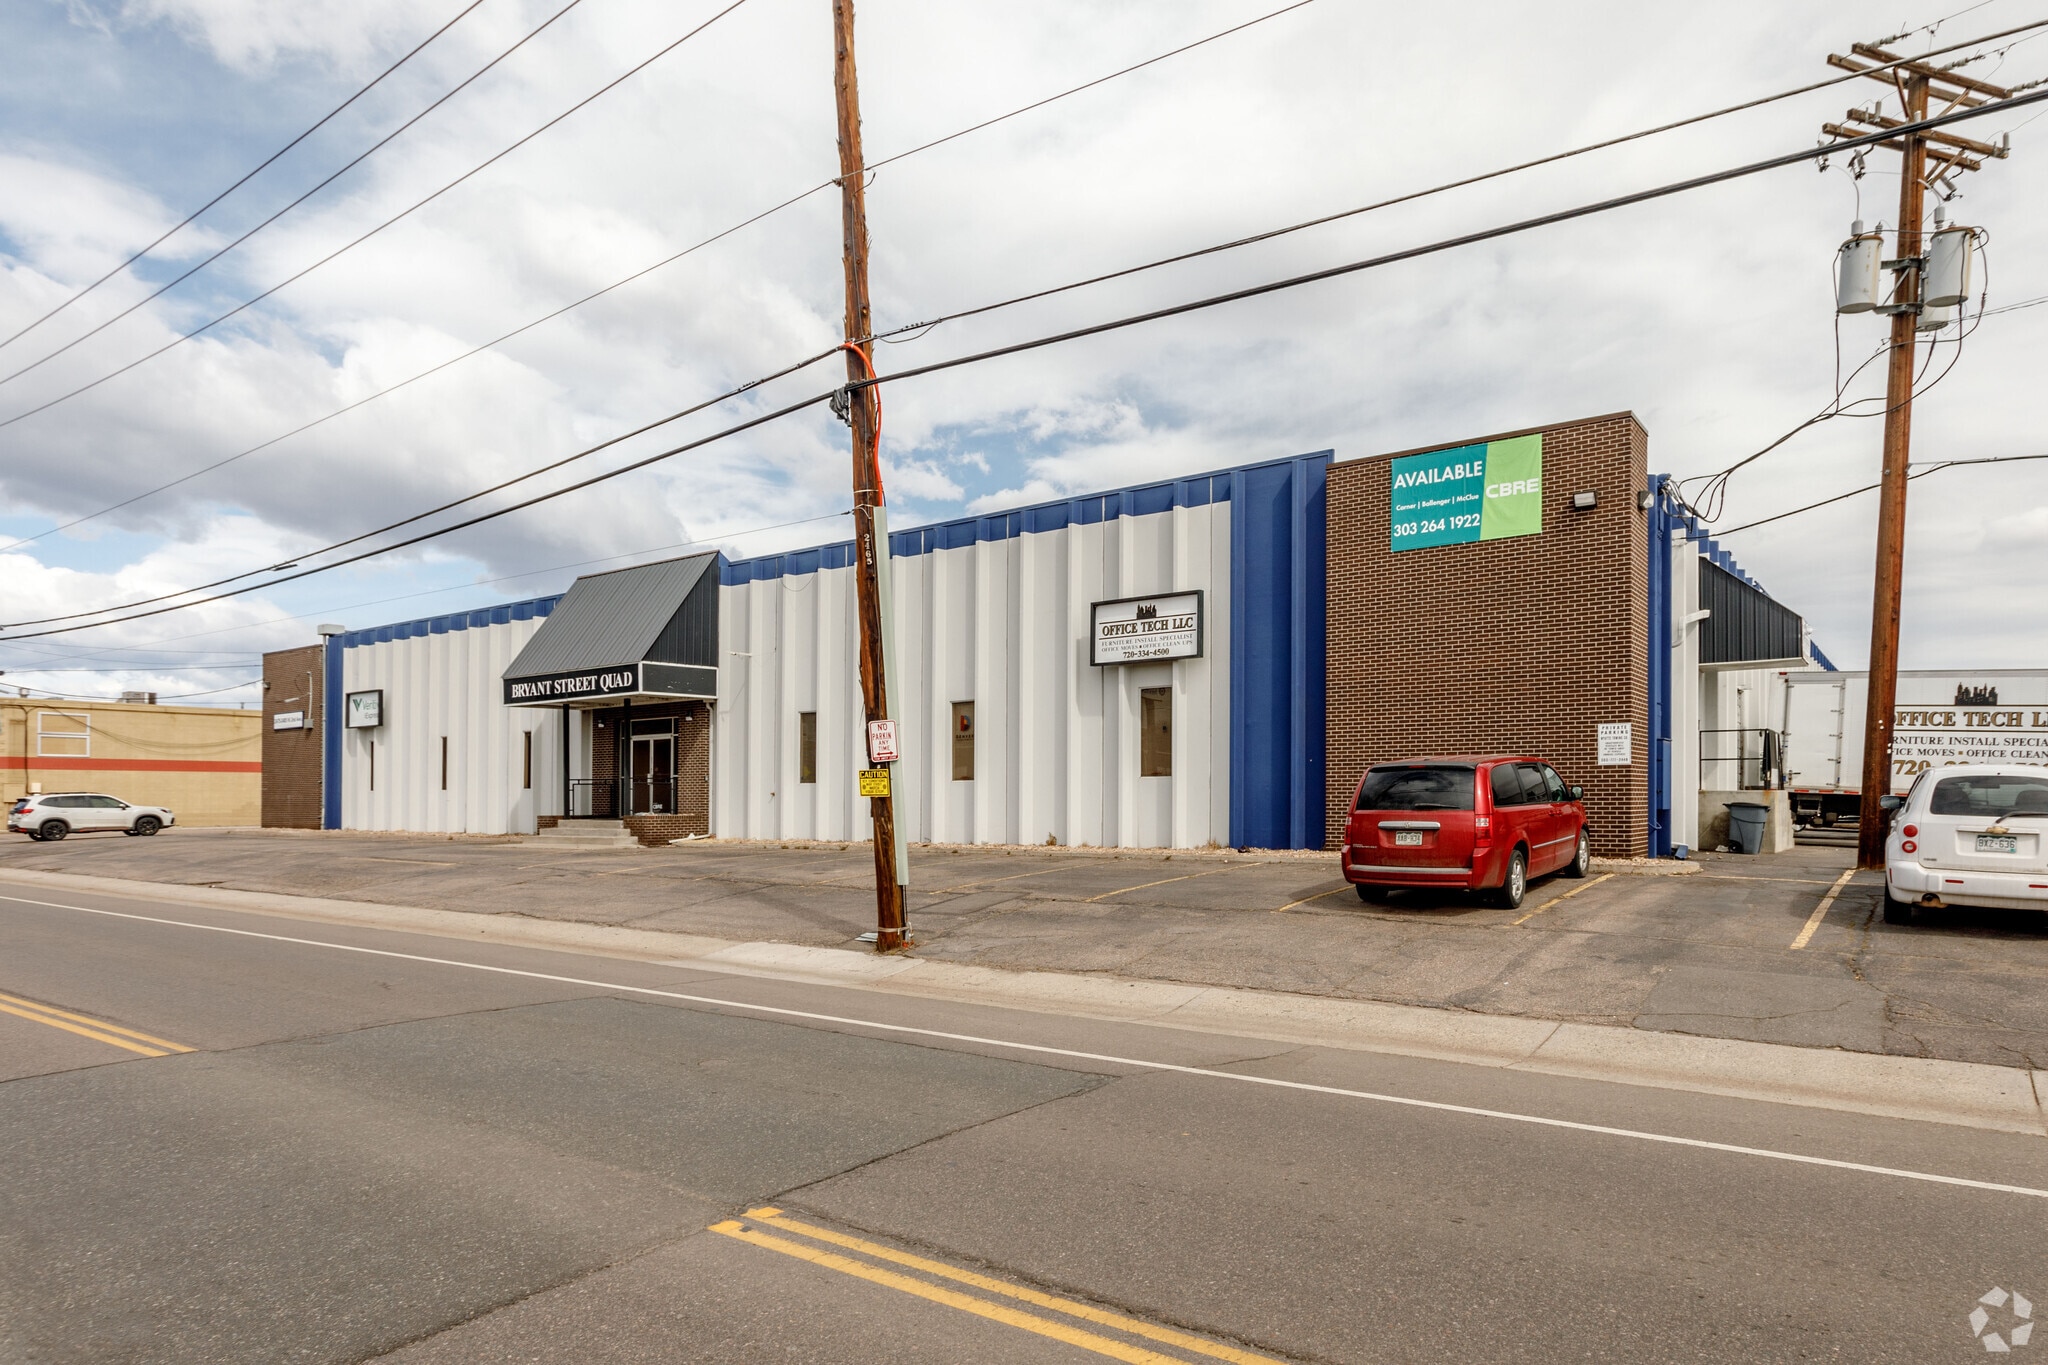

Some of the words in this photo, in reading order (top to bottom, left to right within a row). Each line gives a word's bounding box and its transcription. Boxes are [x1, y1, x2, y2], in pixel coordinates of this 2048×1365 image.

[1393, 461, 1483, 489] AVAILABLE
[1485, 477, 1540, 499] CBRE
[1456, 493, 1479, 502] McClue
[1393, 522, 1418, 537] 303
[1420, 518, 1446, 534] 264
[1449, 513, 1481, 530] 1922
[1102, 622, 1138, 636] OFFICE
[1140, 619, 1169, 633] TECH
[1172, 617, 1193, 629] LLC
[1101, 638, 1132, 647] FURNITURE
[1159, 633, 1193, 641] SPECIALIST
[1123, 648, 1170, 659] 720-334-4500
[511, 680, 553, 698] BRYANT
[554, 675, 598, 694] STREET
[600, 671, 633, 692] QUAD
[1894, 711, 1956, 727] FFICE
[1963, 711, 2024, 728] TECH
[2031, 711, 2048, 728] L
[877, 723, 888, 731] NO
[1893, 736, 1944, 745] RNITURE
[1949, 736, 2000, 746] INSTALL
[1917, 748, 1955, 756] MOVES
[1966, 749, 2007, 758] OFFICE
[859, 770, 888, 779] CAUTION
